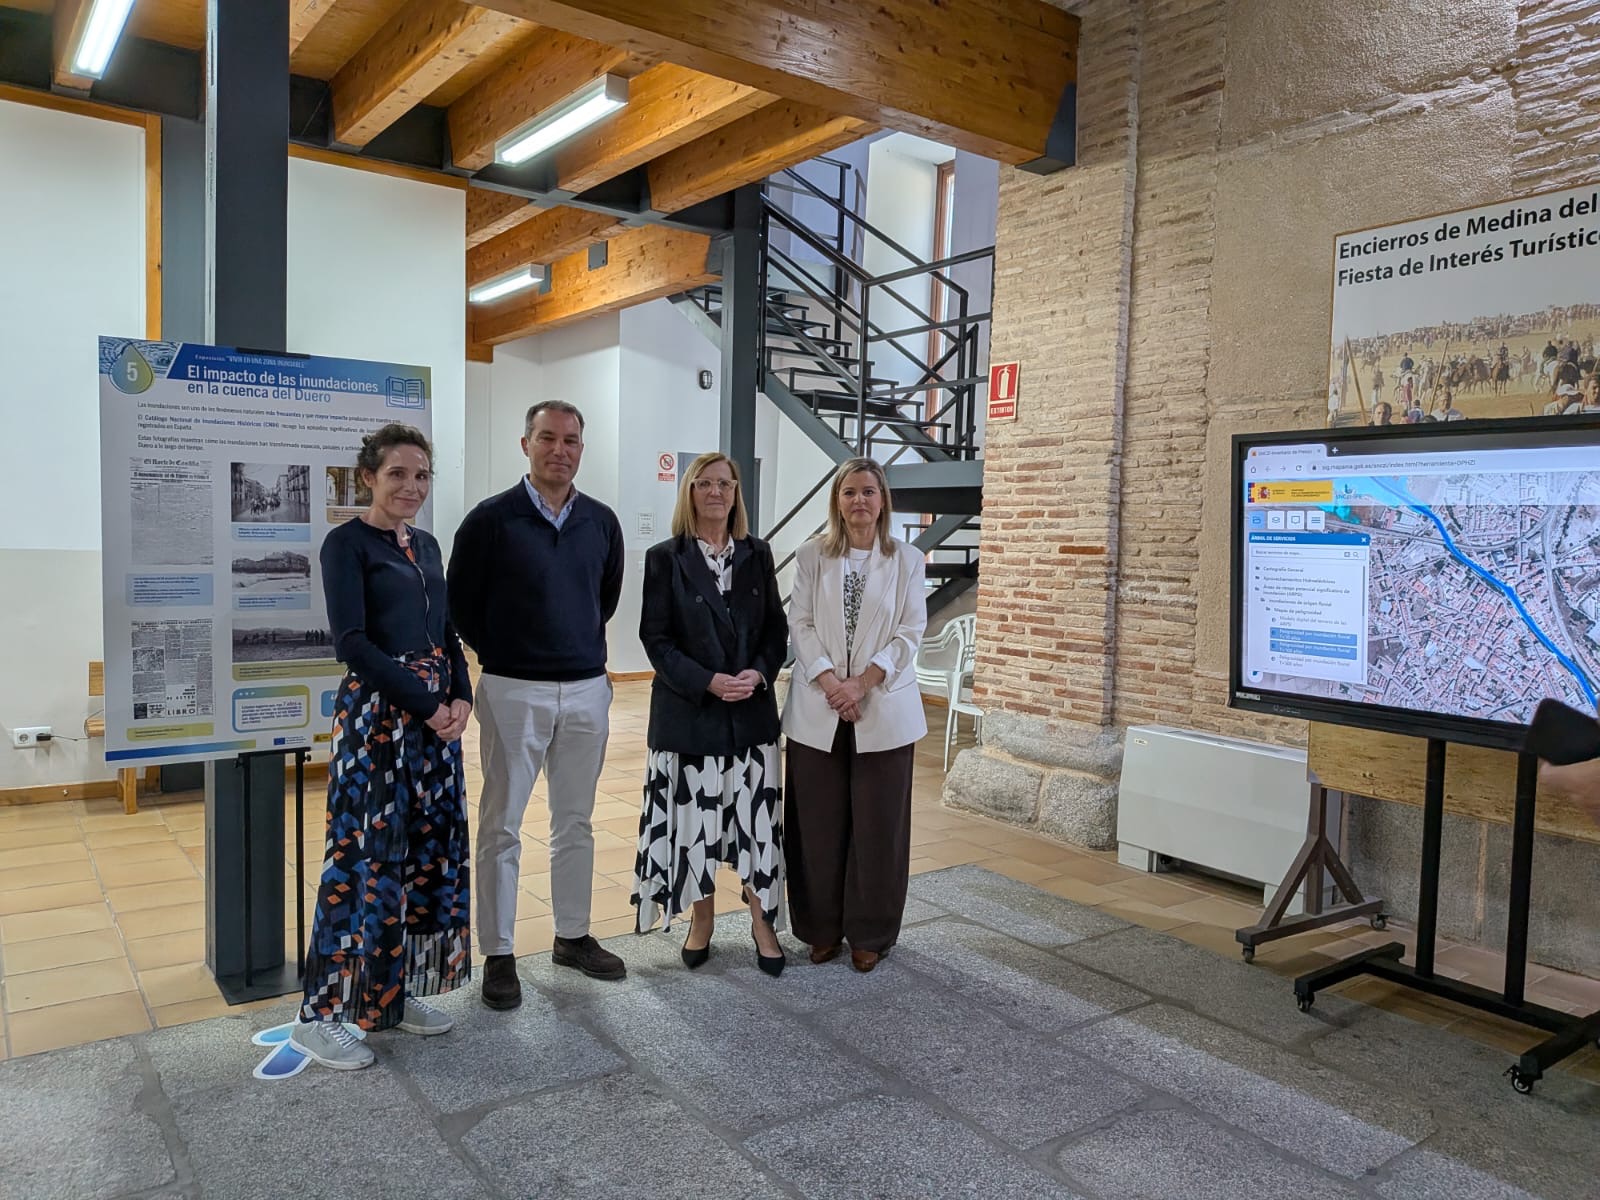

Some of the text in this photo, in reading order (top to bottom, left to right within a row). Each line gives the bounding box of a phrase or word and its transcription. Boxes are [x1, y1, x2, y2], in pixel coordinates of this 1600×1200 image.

[1339, 192, 1598, 260] Encierros de Medina del
[1338, 226, 1600, 287] Fiesta de Interés Turístic
[127, 361, 138, 382] 5
[187, 364, 379, 393] El impacto de las inundaciones
[188, 381, 331, 403] en la cuenca del Duero
[167, 708, 196, 716] LIBRO
